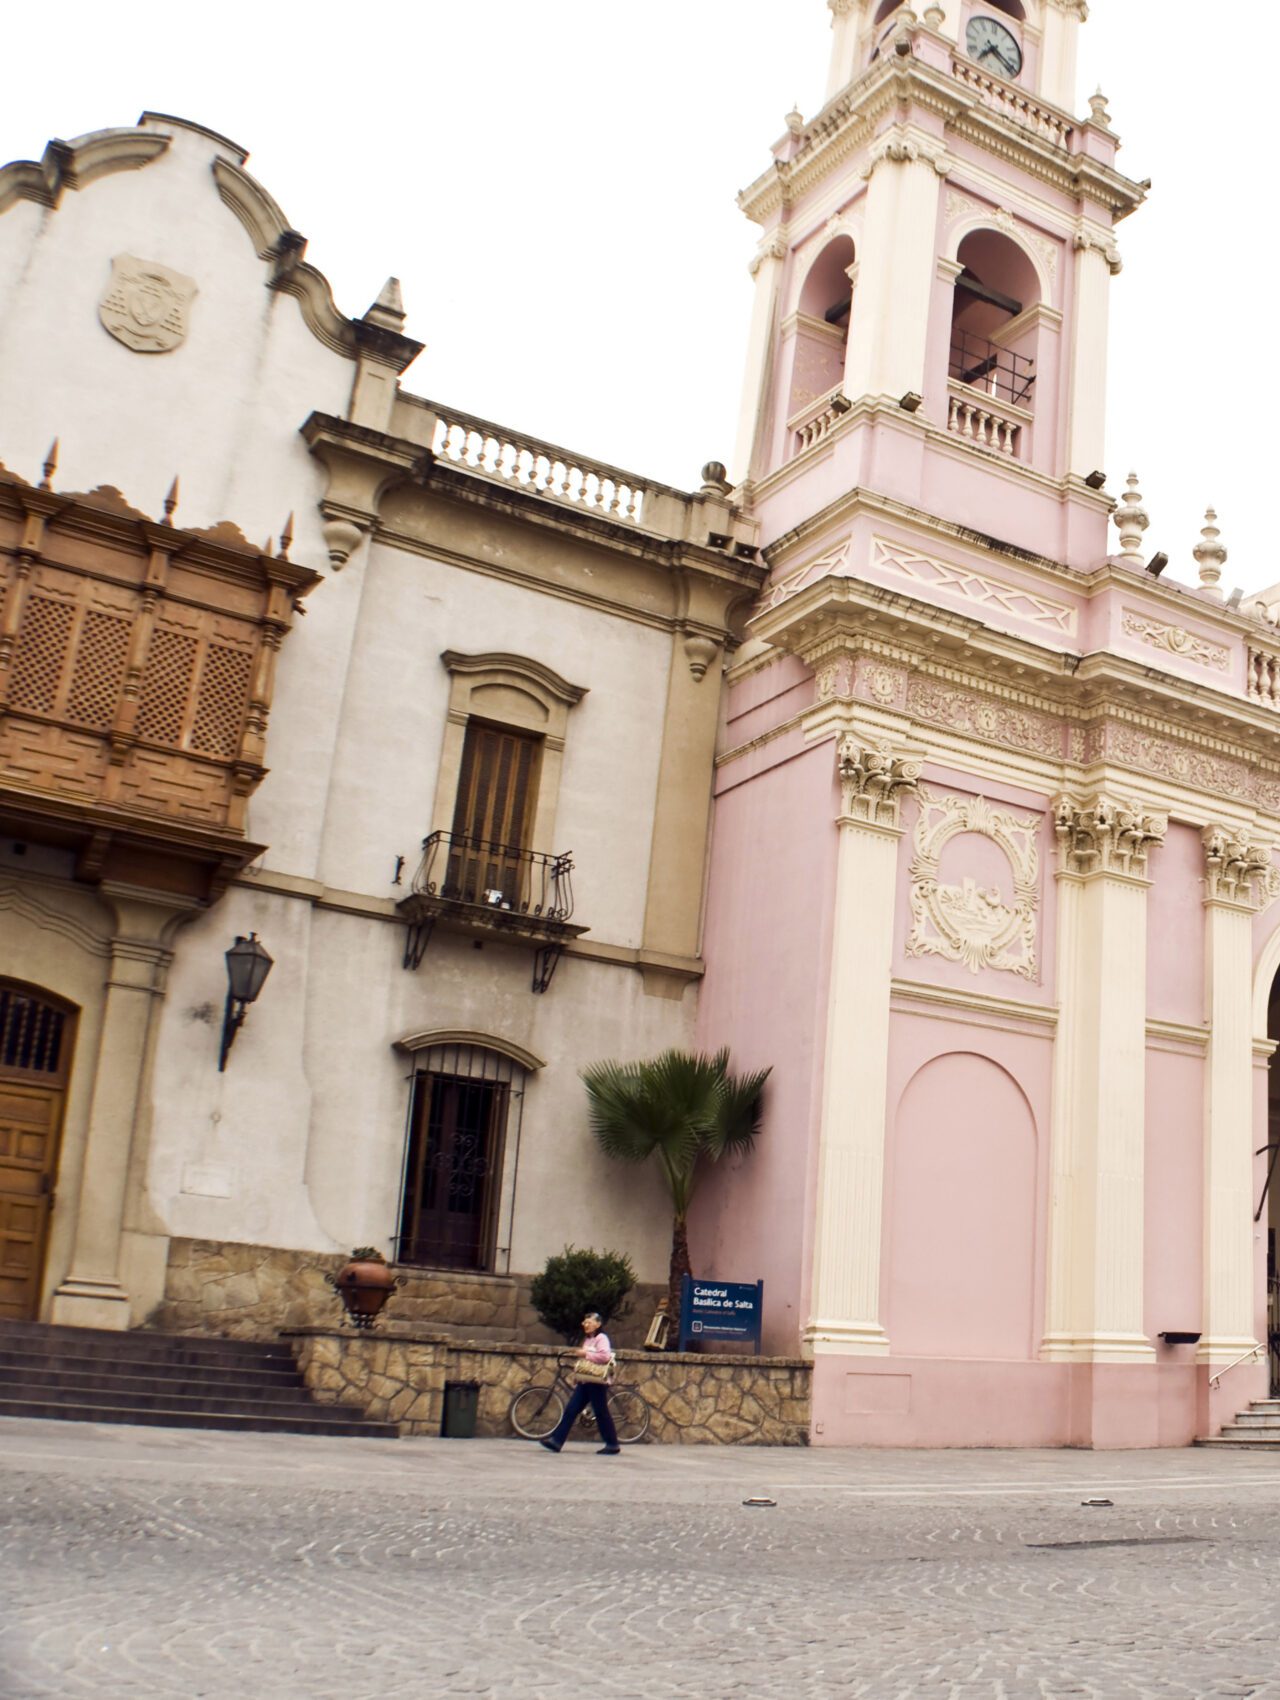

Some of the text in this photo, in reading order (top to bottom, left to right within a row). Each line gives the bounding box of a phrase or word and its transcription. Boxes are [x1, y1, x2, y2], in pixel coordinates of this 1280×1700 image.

[694, 1287, 727, 1297] Catedral
[723, 1300, 733, 1308] de
[735, 1300, 753, 1309] Salta
